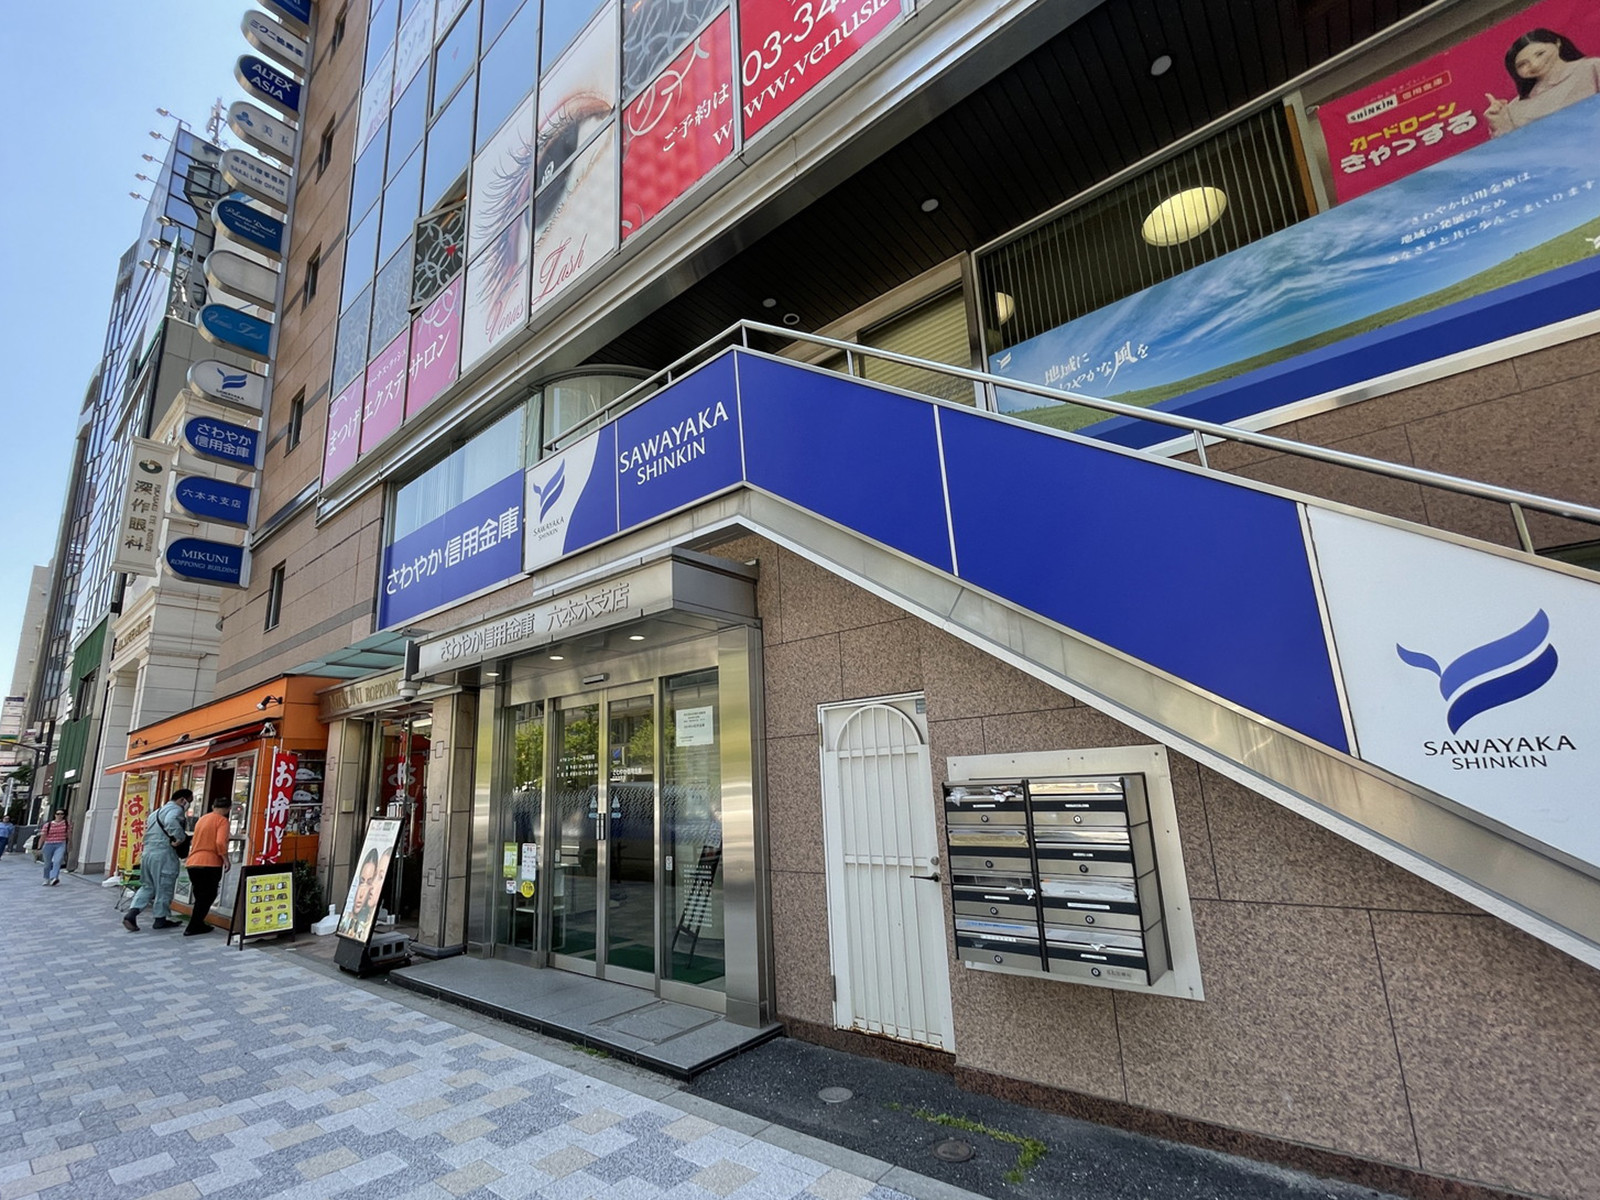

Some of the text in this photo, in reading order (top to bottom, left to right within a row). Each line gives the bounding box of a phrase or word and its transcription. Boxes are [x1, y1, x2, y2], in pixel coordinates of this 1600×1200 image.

[251, 76, 284, 100] ASIA
[252, 64, 293, 92] ALTEX
[663, 83, 729, 152] ご予約は
[1350, 101, 1456, 153] カードローン
[531, 233, 588, 306] Lash
[194, 434, 251, 459] 信用金庫
[196, 423, 252, 447] さわやか
[619, 401, 729, 474] SAWAYAKA
[636, 436, 706, 486] SHINKIN
[182, 487, 242, 509] 六本木支店
[533, 516, 565, 537] SAWAYAKA
[181, 549, 230, 565] MIKUNI
[547, 582, 630, 632] 六本木支店
[329, 687, 364, 712] MIKUNI
[1423, 735, 1578, 757] SAWAYAKA
[1452, 754, 1549, 771] SHINKIN
